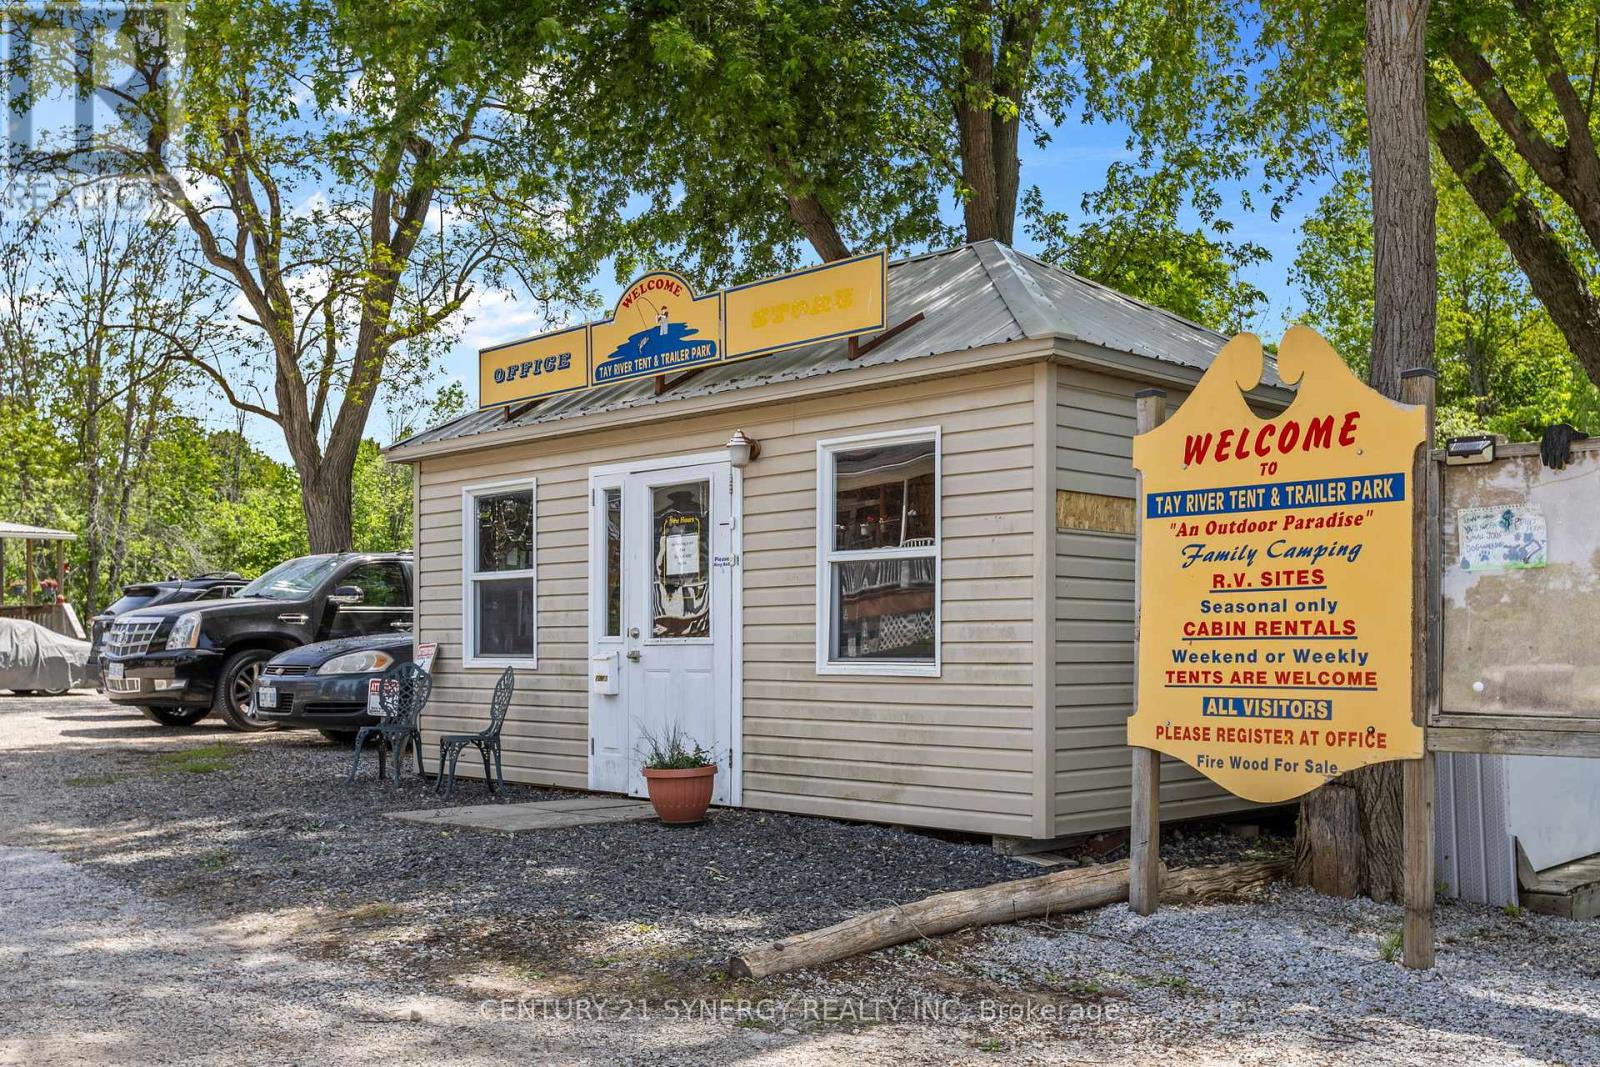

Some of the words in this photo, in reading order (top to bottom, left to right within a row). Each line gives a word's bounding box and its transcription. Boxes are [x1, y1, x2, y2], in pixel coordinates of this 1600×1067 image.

[622, 279, 682, 308] WELCOME
[494, 353, 571, 383] OFFICE
[599, 365, 612, 378] TAY
[613, 361, 632, 376] RIVER
[634, 356, 652, 370] TENT
[653, 354, 659, 367] &
[661, 348, 690, 365] TRAILER
[691, 343, 711, 359] PARK
[1183, 411, 1361, 468] WELCOME
[1259, 461, 1278, 477] TO
[1156, 494, 1182, 515] TAY
[1185, 492, 1225, 513] RIVER
[1229, 488, 1266, 509] TENT
[1270, 486, 1281, 507] &
[1286, 481, 1347, 505] TRAILER
[1351, 477, 1394, 500] PARK
[1205, 518, 1278, 537] Outdoor
[1181, 543, 1260, 569] Family
[1266, 538, 1363, 566] Camping
[1212, 573, 1252, 589] R.V.
[1260, 568, 1326, 587] SITES
[1200, 599, 1288, 614] Seasonal
[1294, 598, 1338, 613] only
[1183, 621, 1247, 637] CABIN
[1254, 619, 1357, 637] RENTALS
[1171, 649, 1258, 664] Weekend
[1265, 652, 1286, 664] or
[1292, 649, 1369, 666] Weekly
[1165, 670, 1223, 684] TENTS
[1230, 671, 1268, 685] ARE
[1274, 671, 1378, 687] WELCOME
[1206, 699, 1238, 716] ALL
[1242, 699, 1329, 719] VISITORS
[1156, 725, 1211, 742] PLEASE
[1216, 728, 1294, 745] REGISTER
[1299, 731, 1320, 746] AT
[1326, 731, 1387, 749] OFFICE
[1196, 754, 1225, 769] Fire
[1229, 756, 1269, 771] Wood
[1274, 758, 1299, 772] For
[1304, 760, 1338, 774] Sale
